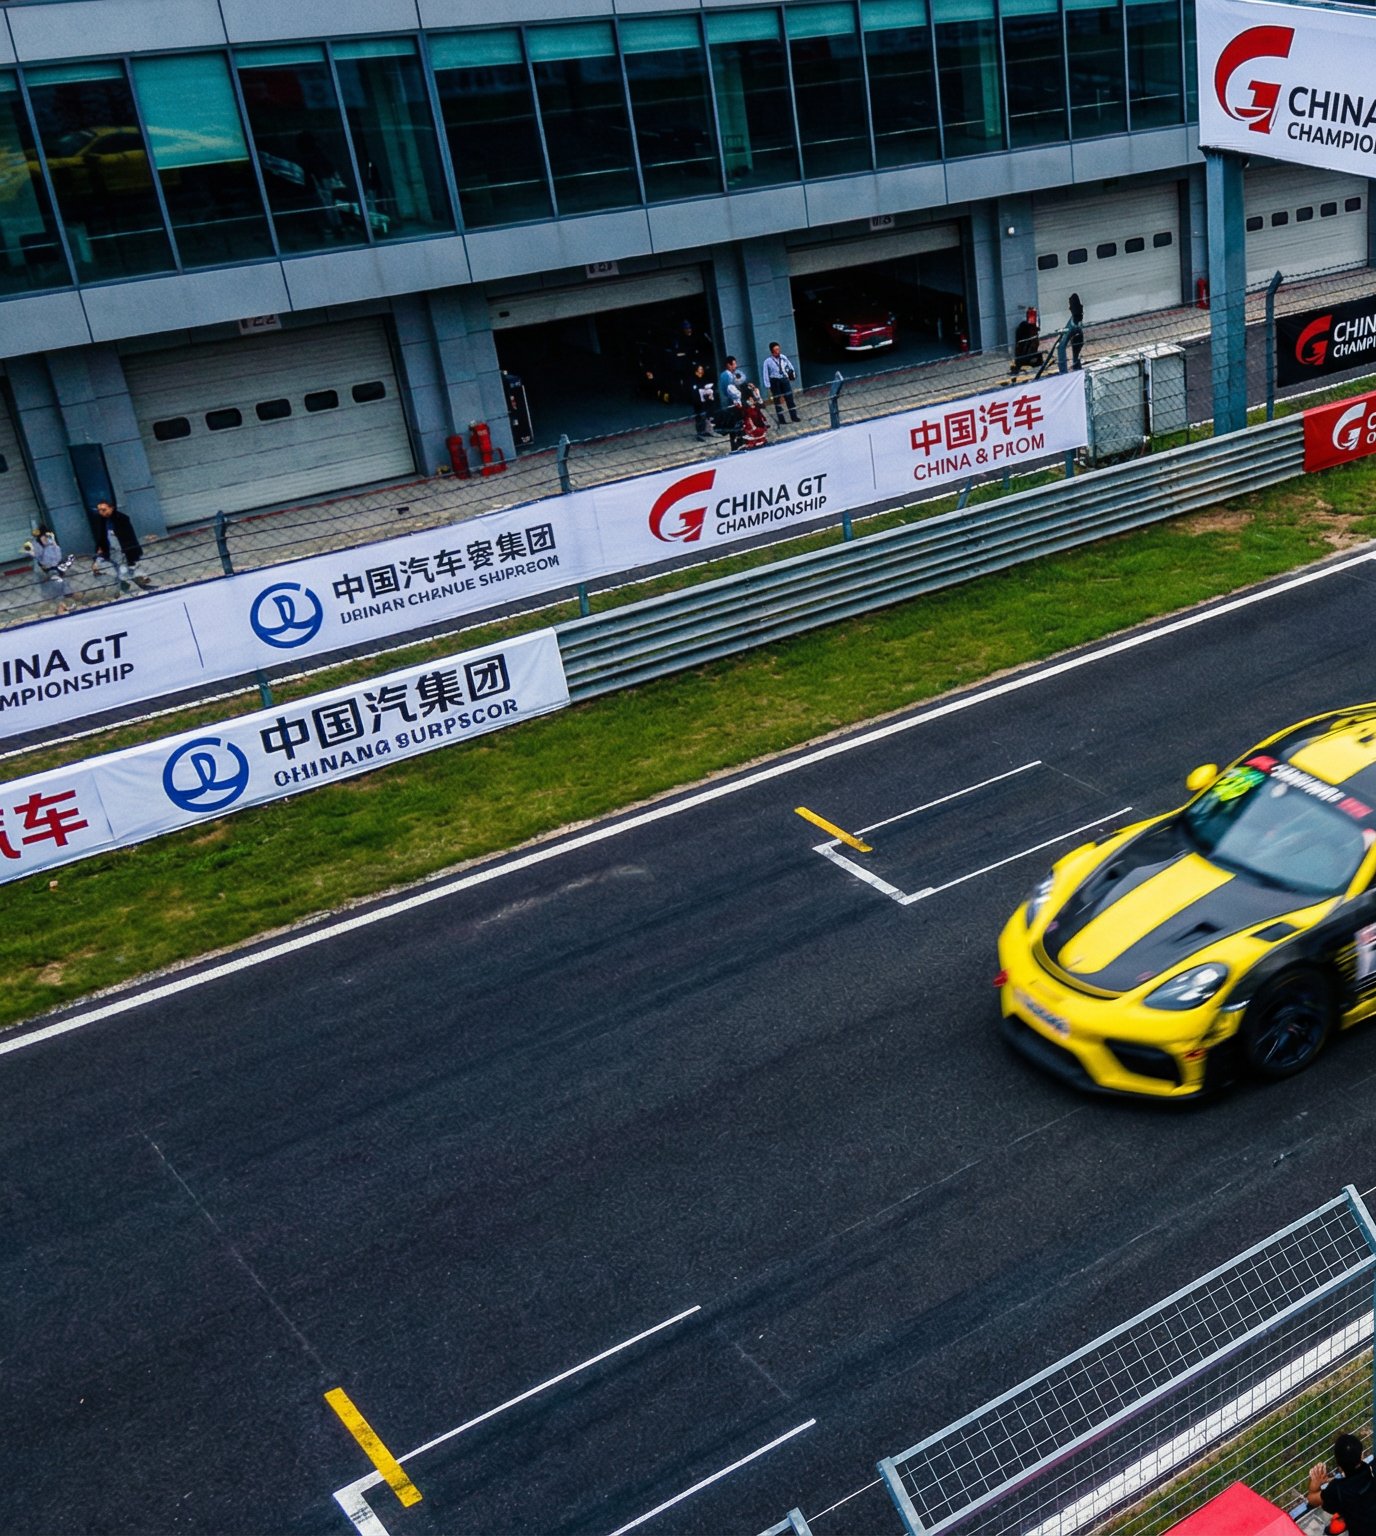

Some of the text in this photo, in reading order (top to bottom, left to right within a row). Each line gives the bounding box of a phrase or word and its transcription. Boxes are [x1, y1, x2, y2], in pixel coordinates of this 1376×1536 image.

[910, 395, 1044, 456] 中国汽车
[914, 453, 972, 480] CHINA
[976, 448, 988, 464] &
[716, 473, 827, 518] CHINA GT
[716, 495, 827, 535] CHAMPIONSHIP
[80, 631, 128, 665] GT
[259, 653, 511, 761] 中国汽集团
[0, 789, 89, 859] 车
